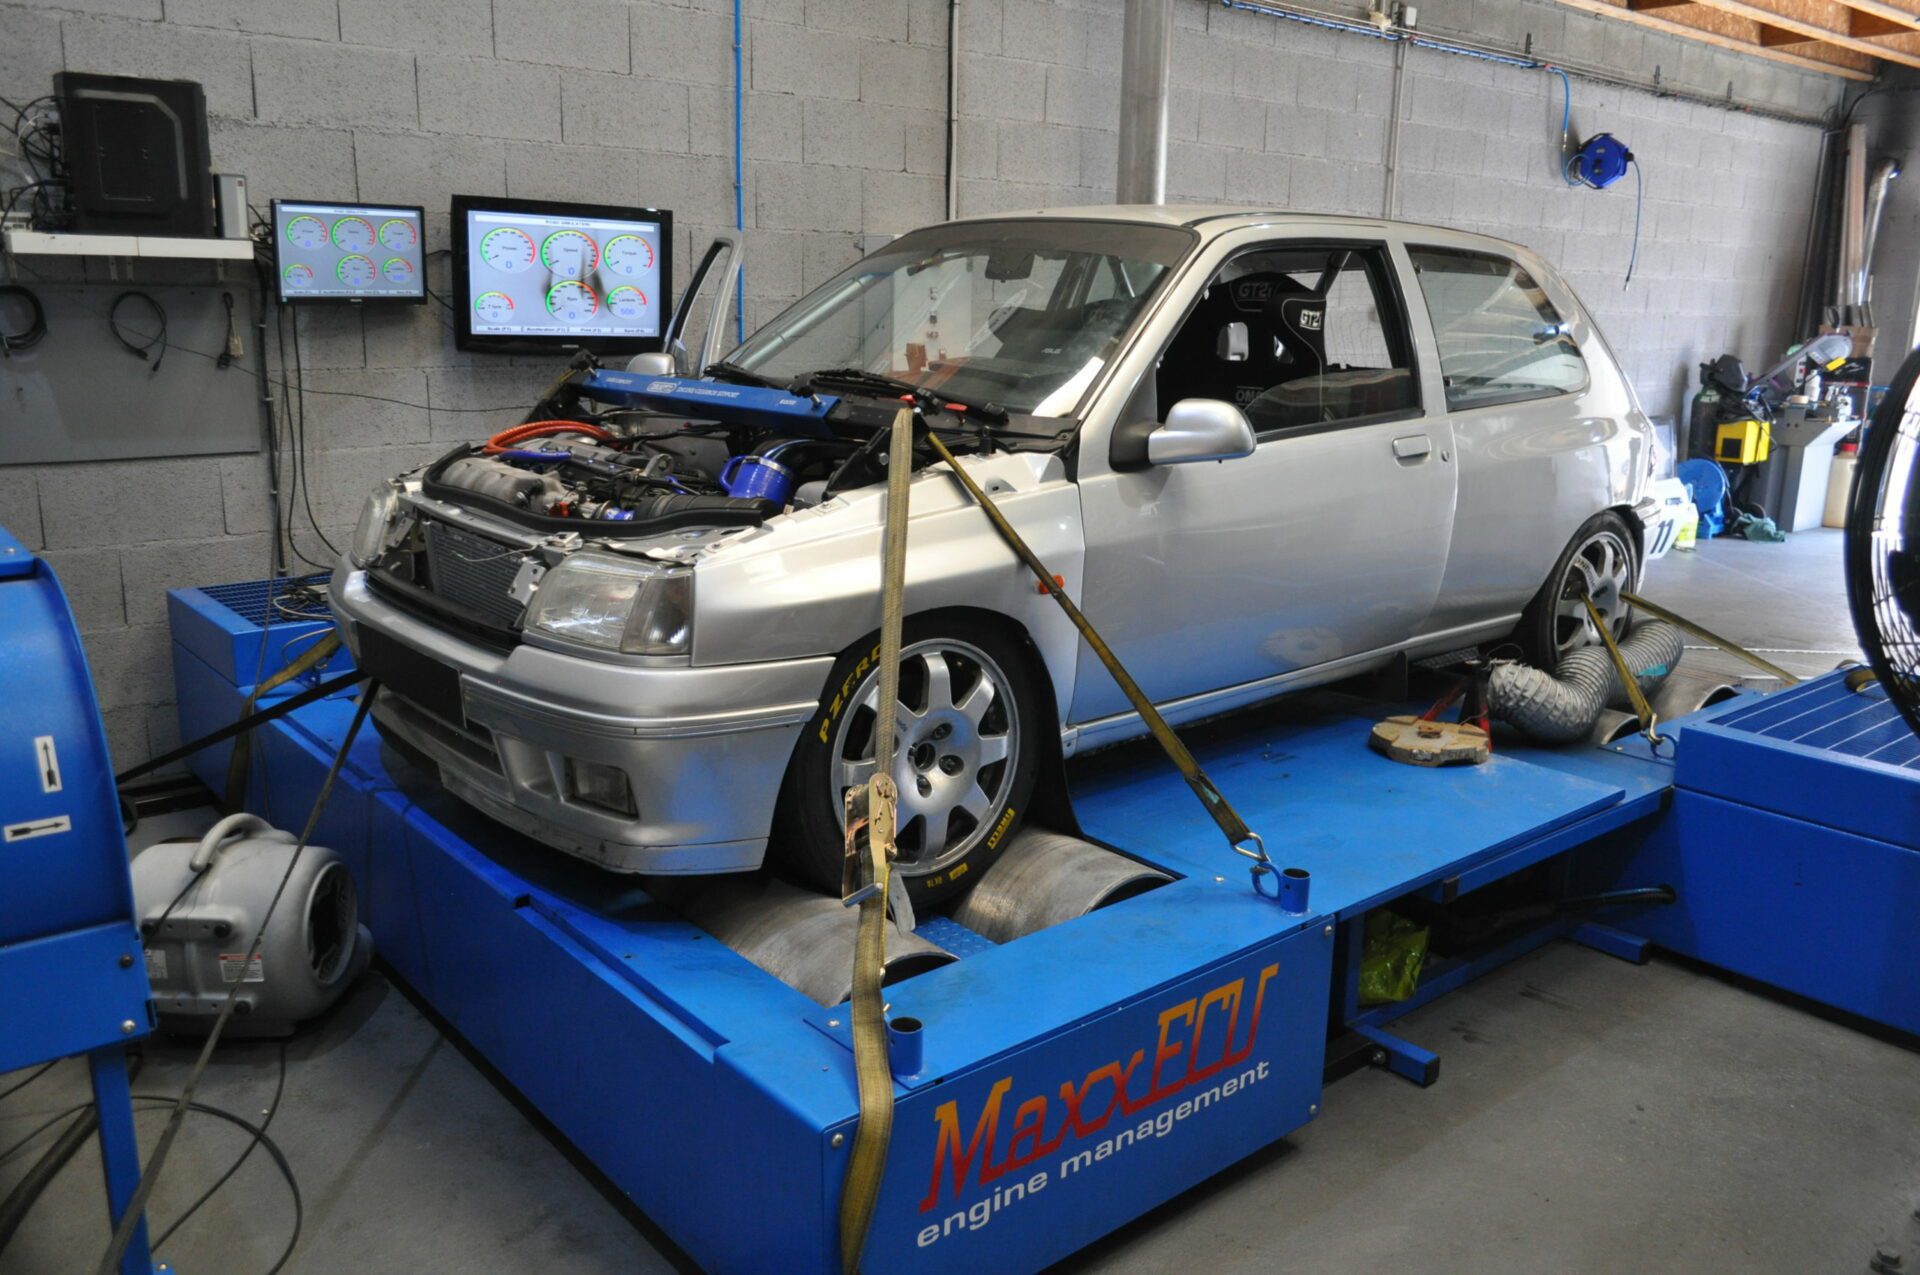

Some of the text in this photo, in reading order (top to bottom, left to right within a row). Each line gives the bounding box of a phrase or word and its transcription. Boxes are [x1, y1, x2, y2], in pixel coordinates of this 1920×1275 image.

[505, 260, 513, 269] 0
[568, 267, 575, 275] 0
[625, 266, 633, 274] 0
[492, 311, 499, 319] 0
[568, 311, 576, 320] 0
[1650, 519, 1675, 554] 11
[919, 963, 1280, 1214] MaxxECU
[916, 1061, 1270, 1248] engine management
